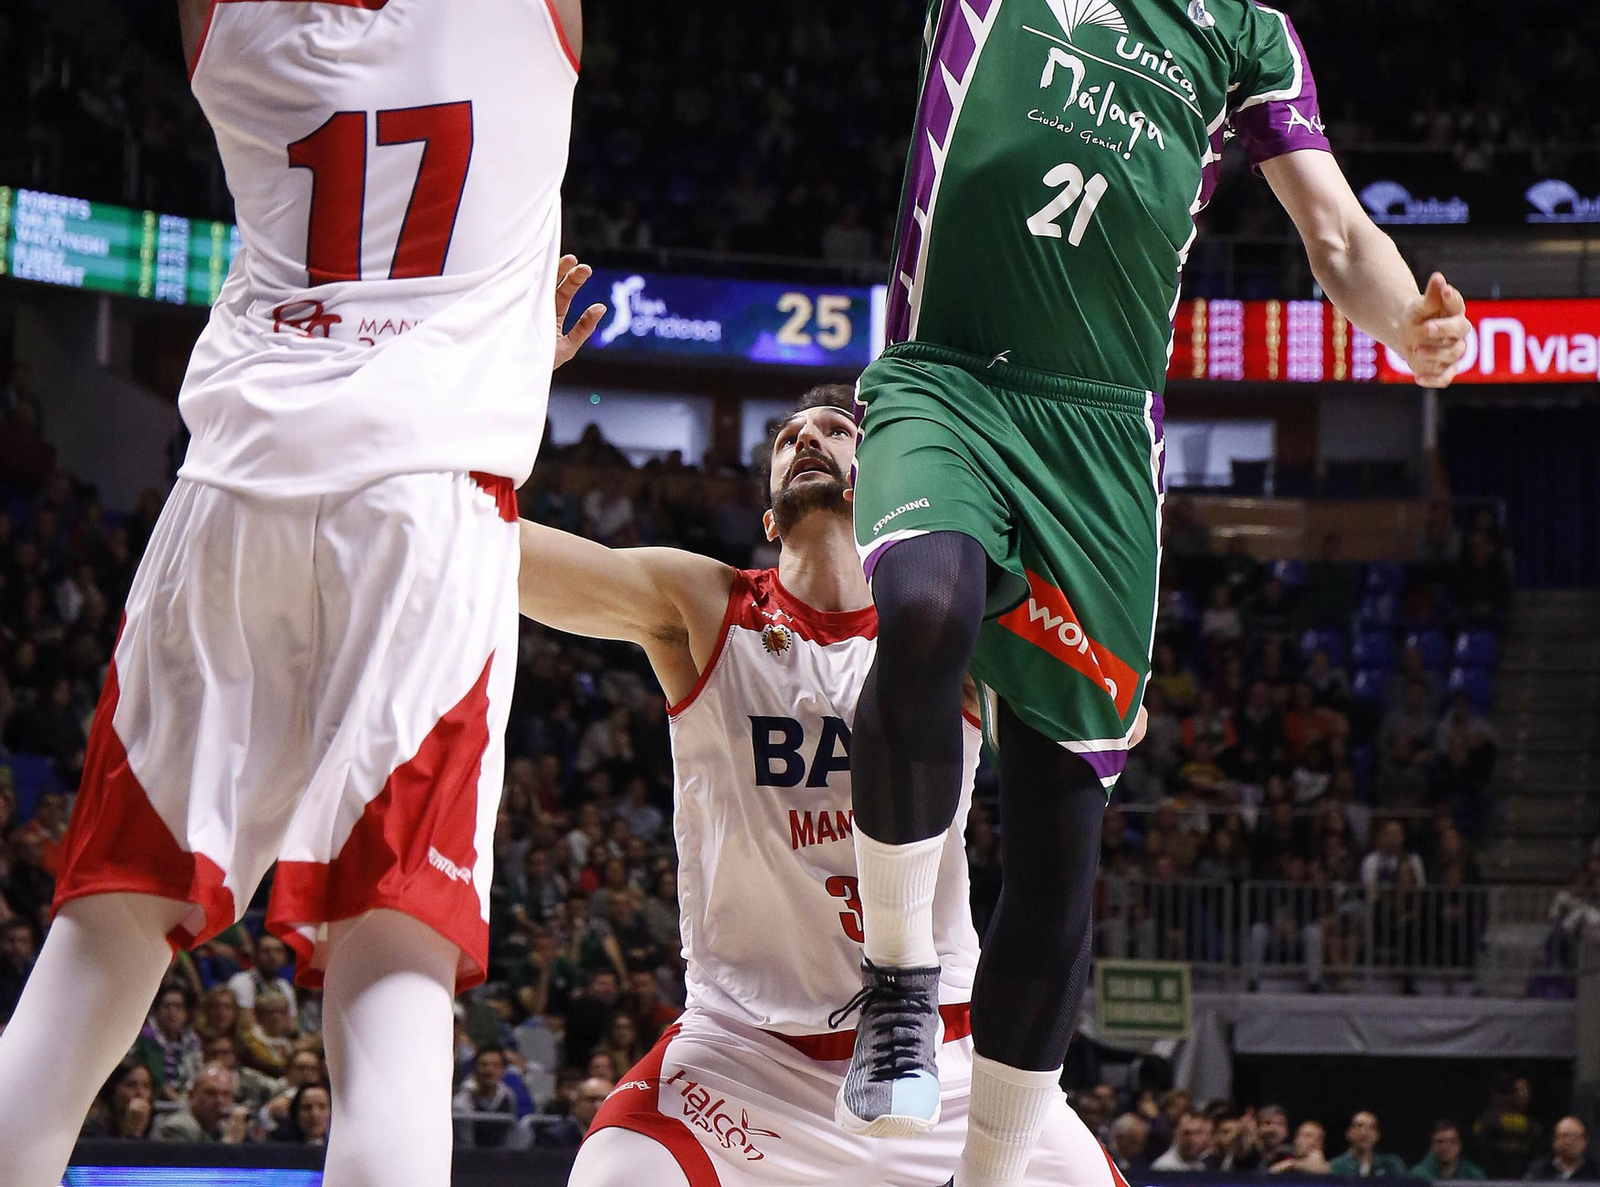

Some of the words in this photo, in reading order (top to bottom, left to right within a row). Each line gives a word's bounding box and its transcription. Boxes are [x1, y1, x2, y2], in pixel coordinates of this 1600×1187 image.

[1027, 109, 1074, 133] Ciudad
[288, 100, 473, 288] 17
[1026, 163, 1109, 247] 21
[776, 292, 853, 351] 25
[872, 497, 931, 536] SPALDING
[747, 715, 853, 788] BA
[788, 809, 853, 850] MAN
